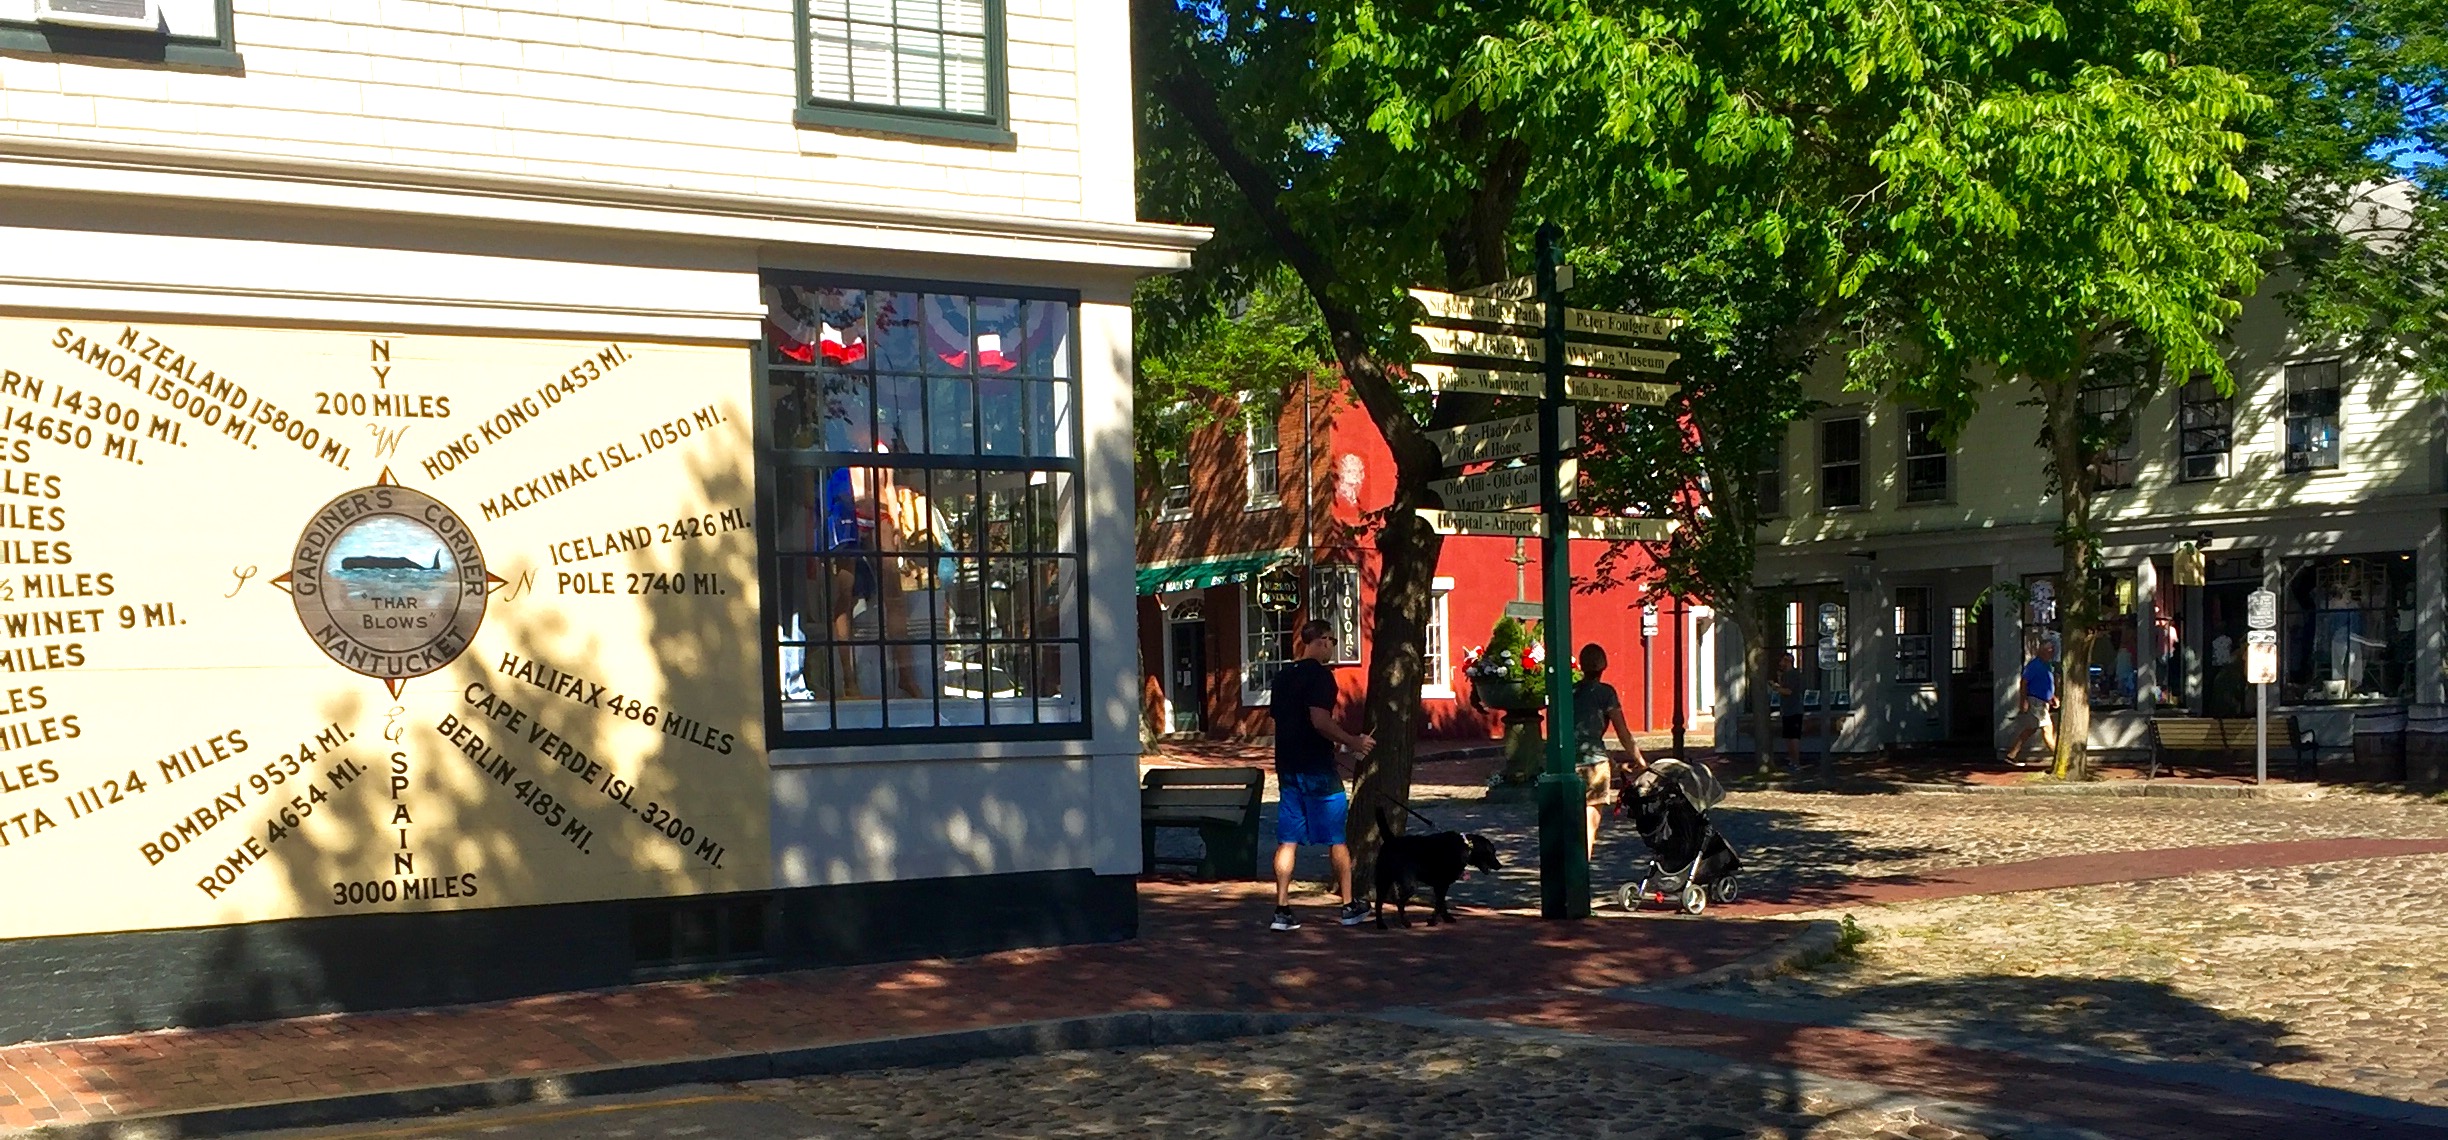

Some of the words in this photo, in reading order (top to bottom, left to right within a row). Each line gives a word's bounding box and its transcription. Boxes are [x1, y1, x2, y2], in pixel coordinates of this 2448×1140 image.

[1516, 307, 1539, 322] Path
[1576, 312, 1604, 329] Peter
[1608, 316, 1650, 336] Foulger
[1652, 320, 1663, 336] &
[1438, 372, 1468, 391] Polpis
[1567, 346, 1615, 367] Whaling
[1618, 350, 1665, 369] Museum
[0, 369, 44, 403] RN
[51, 384, 140, 431] 14300
[147, 414, 188, 448] MI.
[51, 326, 144, 390] SAMOA
[147, 374, 223, 427] 15000
[223, 413, 258, 450] MI.
[116, 325, 248, 411] N.ZEALAND
[250, 397, 320, 450] 15800
[319, 437, 350, 471] MI.
[315, 392, 366, 416] 200
[372, 394, 451, 418] MILES
[420, 433, 479, 481] HONG
[479, 397, 540, 446] KONG
[536, 359, 601, 409] 10453
[597, 343, 633, 373] MI.
[1571, 380, 1591, 397] Info.
[1593, 382, 1609, 398] Bur.
[1617, 384, 1635, 400] Rest
[3, 406, 92, 449] 14650
[102, 433, 144, 465] MI.
[1481, 423, 1521, 440] Hadwen
[1524, 418, 1534, 433] &
[1491, 441, 1522, 457] House
[479, 456, 598, 522] MACKINAC
[597, 442, 642, 473] ISL.
[640, 417, 691, 454] 1050
[692, 403, 727, 432] MI.
[1445, 481, 1462, 497] Old
[1465, 478, 1485, 493] Mill
[1493, 473, 1511, 490] Old
[1514, 468, 1538, 486] Gaol
[1437, 513, 1483, 534] Hospital
[1492, 516, 1532, 535] Airport
[1456, 496, 1485, 511] Maria
[1487, 489, 1528, 509] Mitchell
[296, 488, 395, 596] GARDINER'S
[424, 504, 485, 597] CORNER
[549, 526, 652, 566] ICELAND
[658, 514, 717, 545] 2426
[719, 507, 752, 533] MI.
[1604, 521, 1640, 536] Sheriff
[22, 572, 114, 598] MILES
[557, 572, 614, 595] POLE
[626, 572, 686, 595] 2740
[693, 573, 726, 596] MI.
[1165, 581, 1183, 592] MAIN
[1185, 578, 1195, 590] ST
[118, 604, 136, 629] 9
[142, 602, 187, 628] MI.
[1343, 573, 1354, 657] LIQUORS
[315, 625, 467, 676] NANTUCKET
[498, 652, 606, 709] HALIFAX
[607, 695, 659, 727] 486
[661, 710, 736, 756] MILES
[64, 770, 147, 819] 11124
[156, 728, 249, 784] MILES
[138, 784, 247, 867] BOMBAY
[249, 742, 318, 795] 9534
[314, 721, 356, 754] MI.
[436, 713, 518, 787] BERLIN
[513, 779, 567, 828] 4185
[561, 817, 595, 855] MI.
[464, 682, 527, 734] CAPE
[527, 720, 603, 785] VERDE
[600, 771, 638, 815] ISL.
[640, 801, 695, 847] 3200
[694, 836, 726, 870] MI.
[195, 836, 269, 900] ROME
[265, 784, 328, 844] 4654
[326, 757, 368, 790] MI.
[391, 752, 413, 875] SPAIN
[333, 880, 397, 905] 3000
[403, 873, 478, 900] MILES
